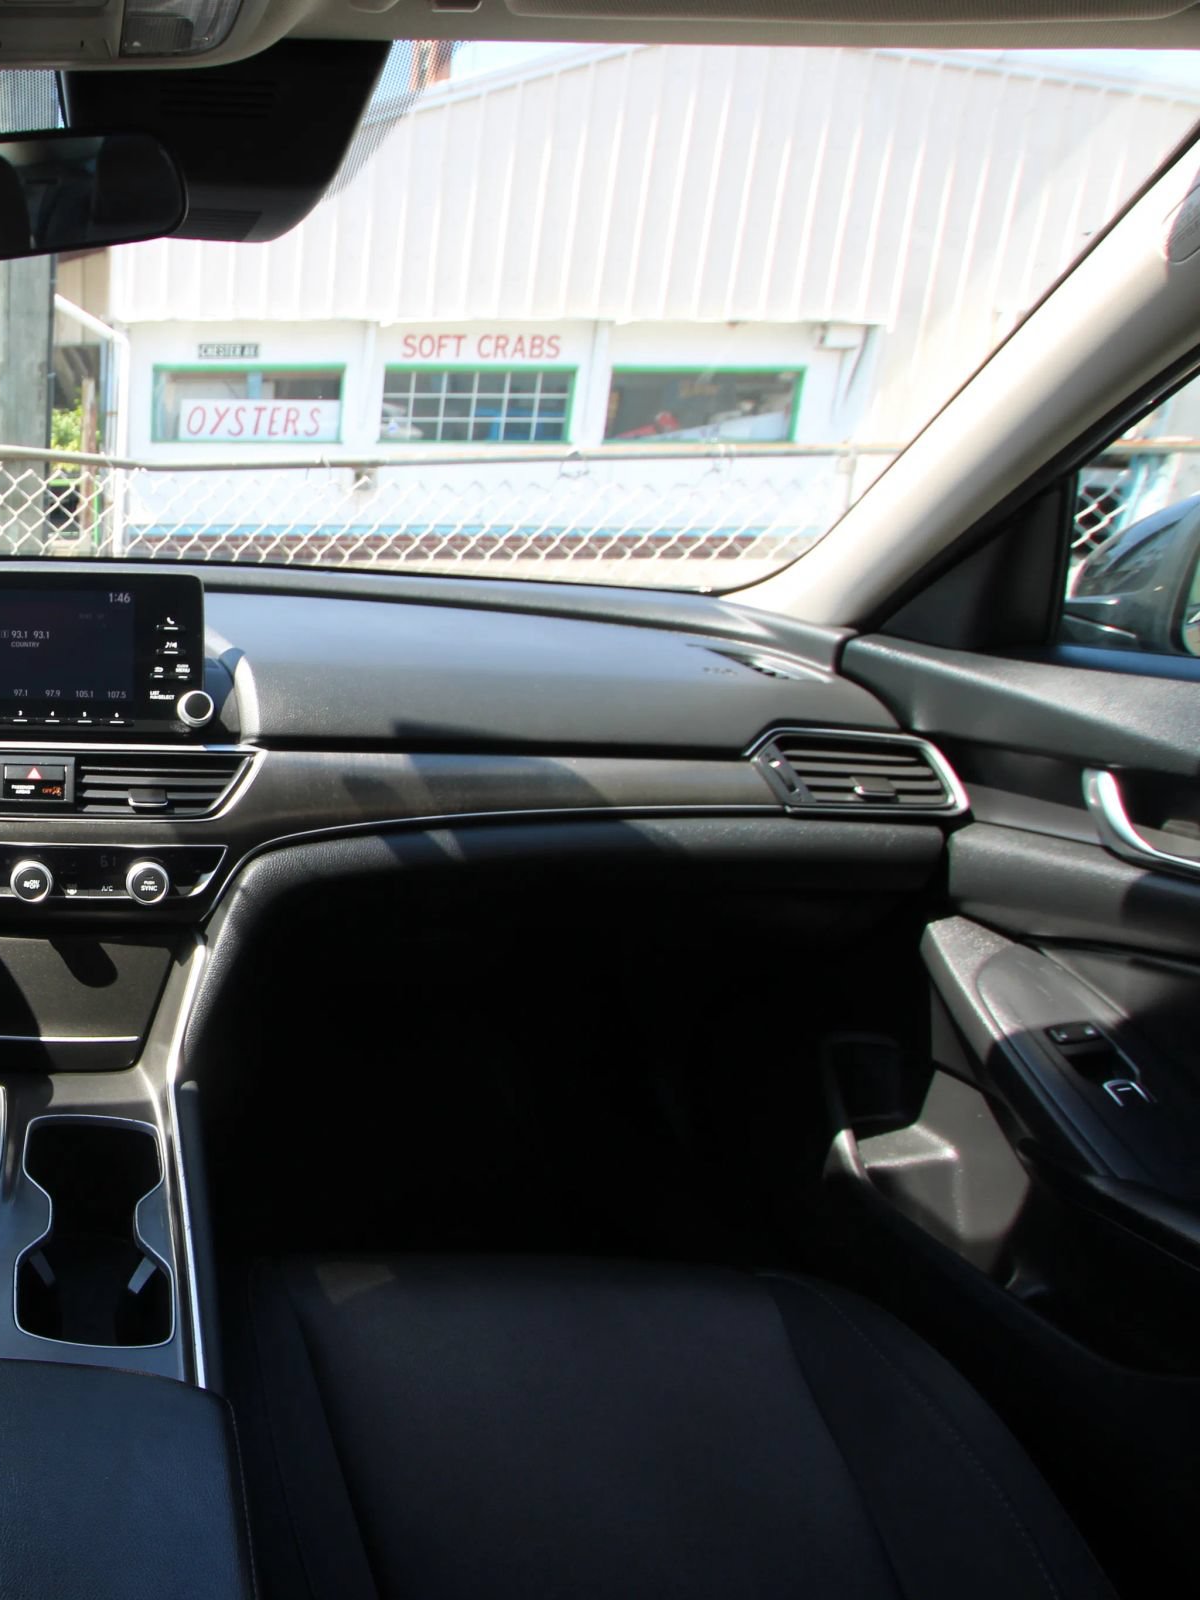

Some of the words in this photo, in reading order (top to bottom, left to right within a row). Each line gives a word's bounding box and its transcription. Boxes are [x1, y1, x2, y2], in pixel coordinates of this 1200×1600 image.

[401, 333, 467, 359] SOFT
[476, 333, 562, 360] CRABS
[186, 404, 321, 437] OYSTERS
[108, 592, 131, 604] 1:46
[11, 630, 28, 639] 93.1
[33, 630, 50, 639] 93.1
[10, 640, 40, 648] COUNTRY
[13, 689, 28, 697] 97.1
[45, 689, 61, 697] 97.9
[75, 690, 94, 698] 105.1
[107, 690, 127, 699] 107.5
[140, 884, 159, 892] SYNC
